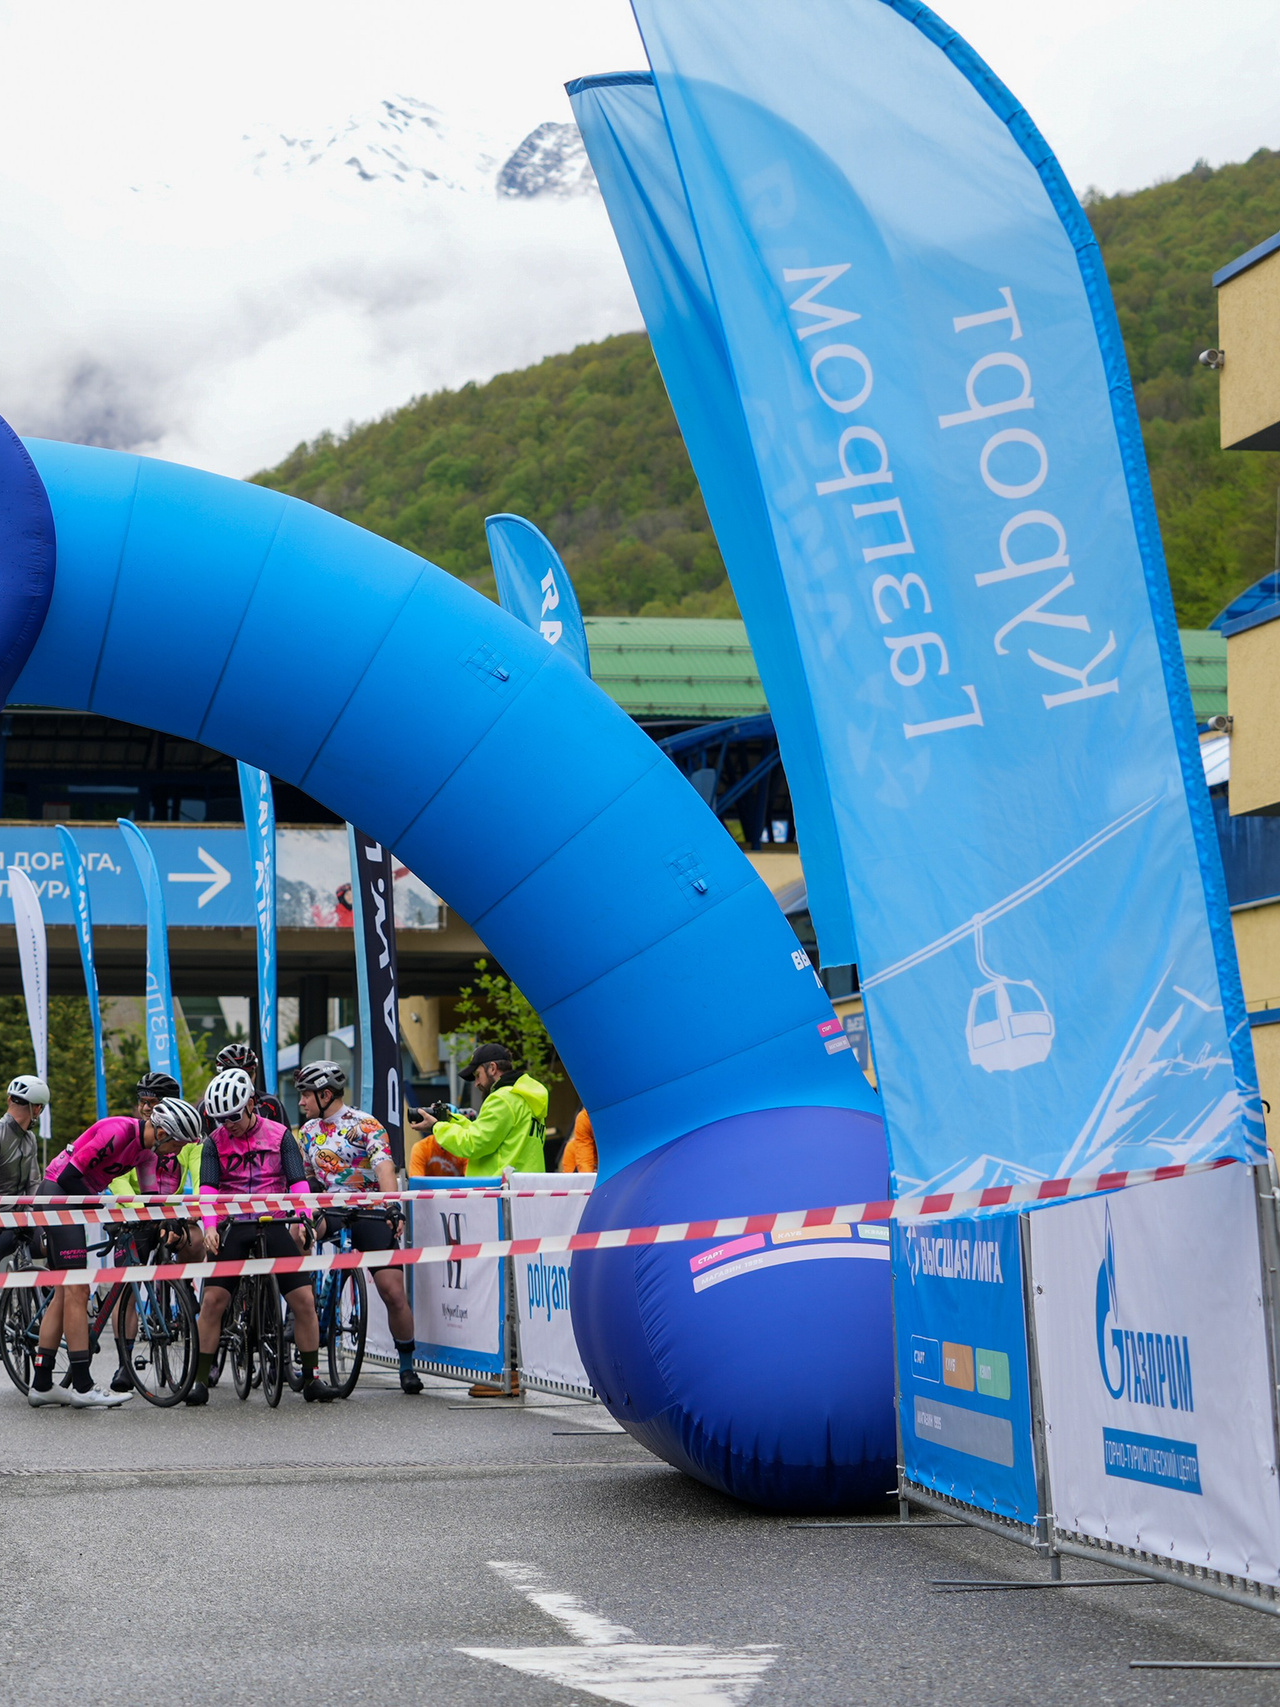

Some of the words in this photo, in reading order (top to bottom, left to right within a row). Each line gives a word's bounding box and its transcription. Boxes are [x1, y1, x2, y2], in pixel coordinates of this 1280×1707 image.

[14, 851, 121, 875] ДОРГА,
[225, 1150, 271, 1172] DRT
[777, 1230, 802, 1239] КЛУБ
[697, 1249, 724, 1265] СТАРТ
[920, 1236, 970, 1280] ВЫСШАЯ
[971, 1240, 1004, 1284] ЛИГА
[527, 1253, 571, 1322] polyan
[1124, 1330, 1194, 1412] ГАЗПРОМ
[1105, 1440, 1177, 1479] ГОРНО-ТУРИСТИЧЕСКИЙ
[1178, 1454, 1197, 1485] ЦЕНТР
